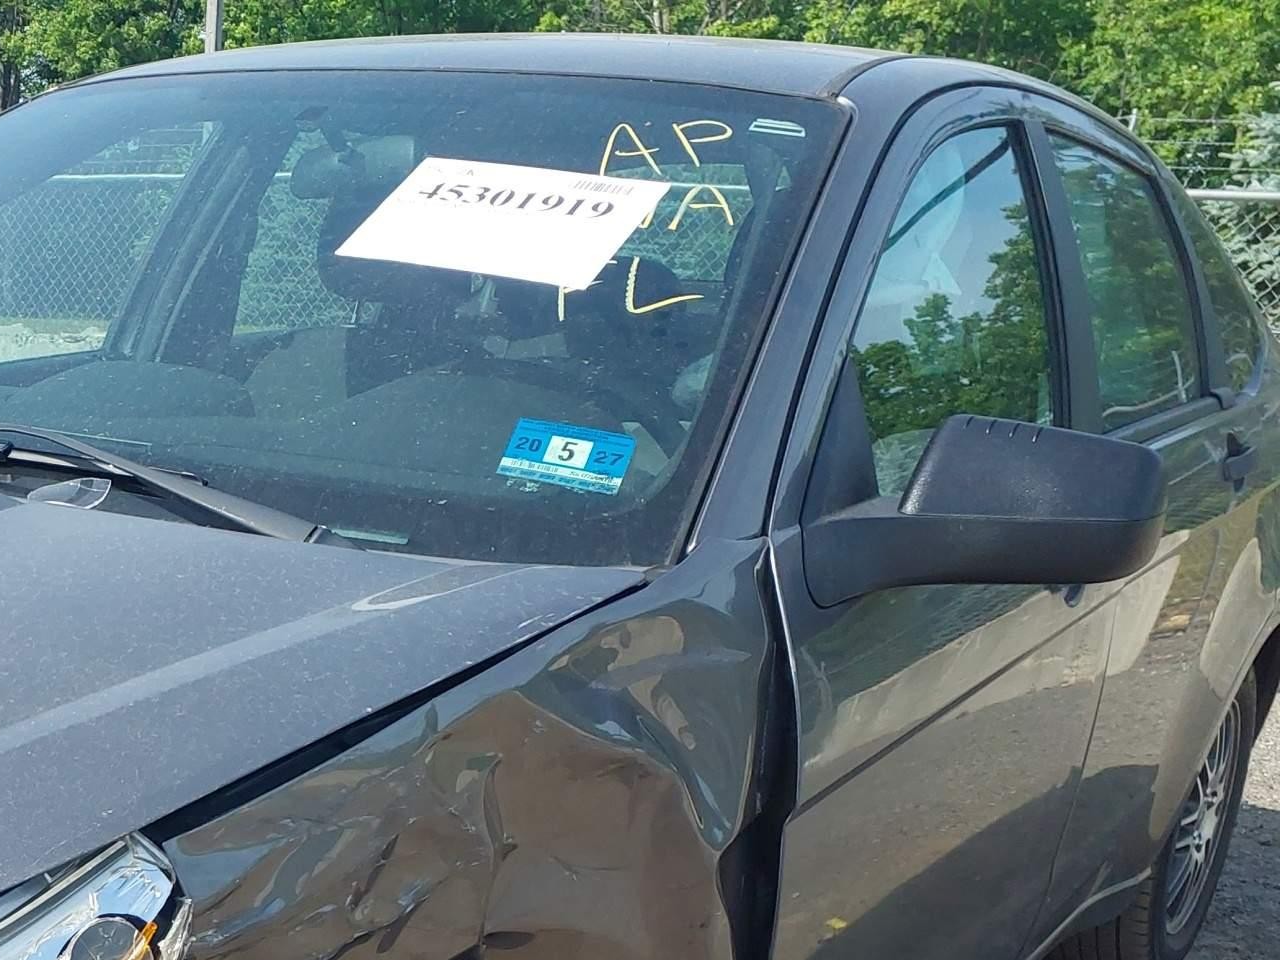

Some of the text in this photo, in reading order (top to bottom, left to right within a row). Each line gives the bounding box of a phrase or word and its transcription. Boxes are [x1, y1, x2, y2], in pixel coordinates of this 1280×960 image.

[418, 182, 615, 219] 45301919
[514, 436, 625, 466] 20 5 27
